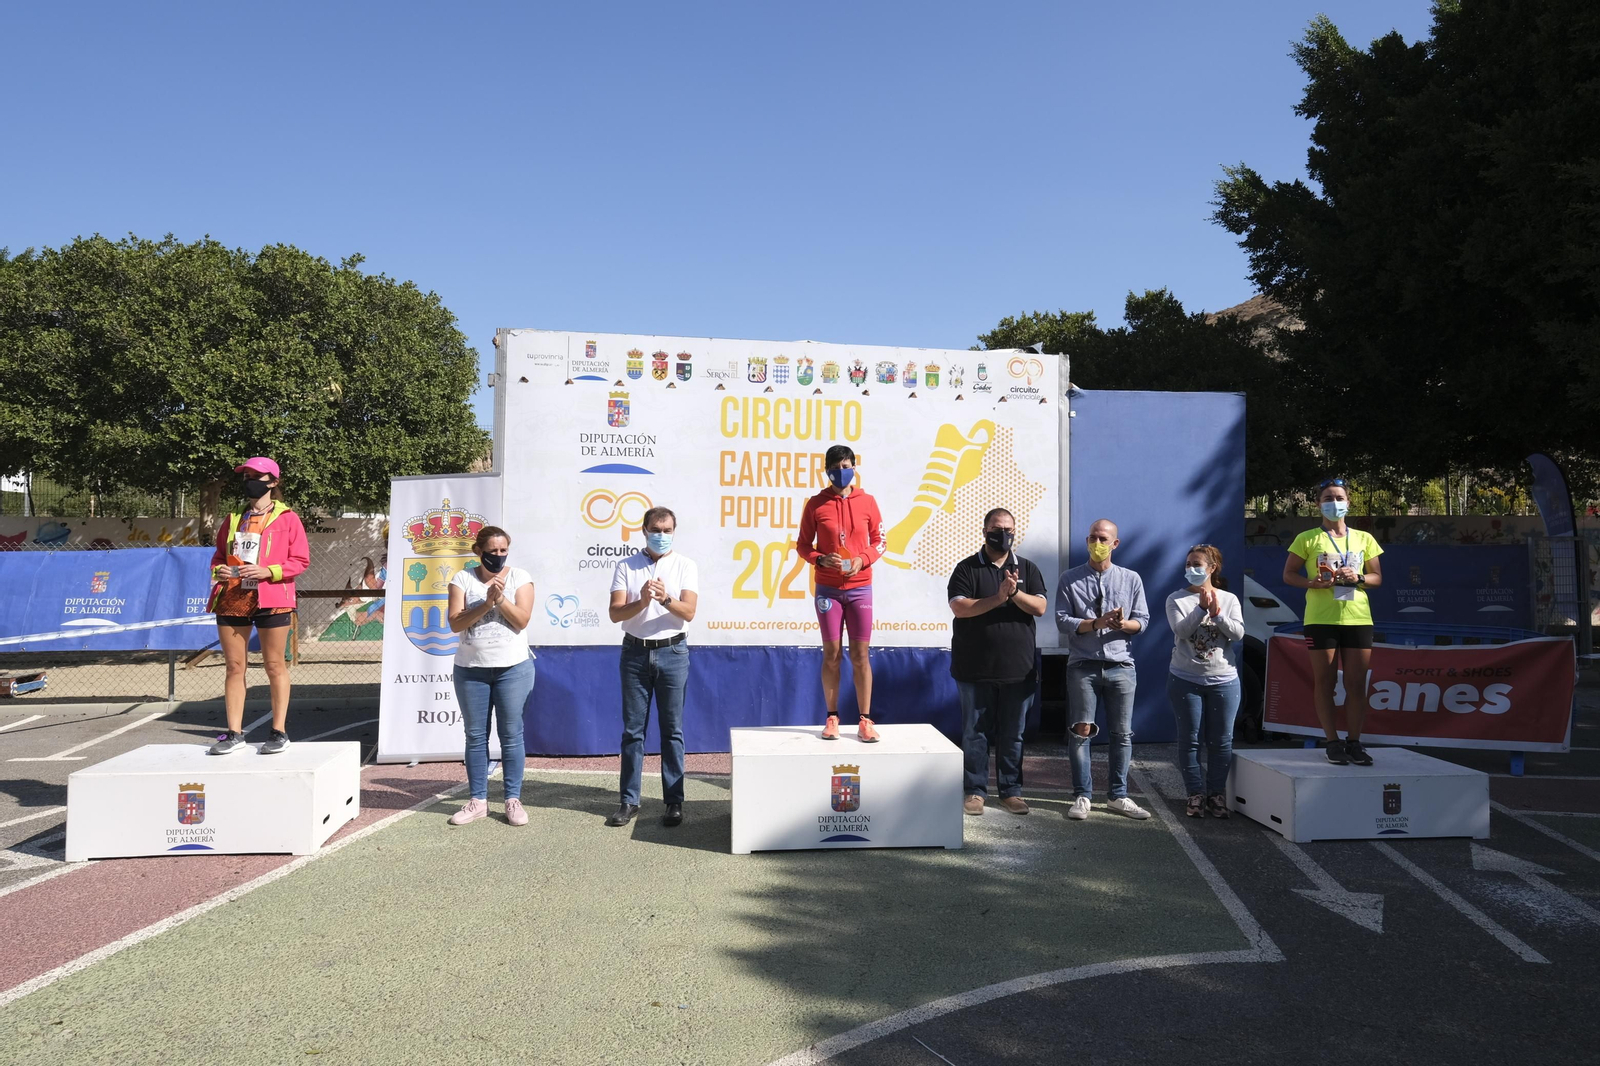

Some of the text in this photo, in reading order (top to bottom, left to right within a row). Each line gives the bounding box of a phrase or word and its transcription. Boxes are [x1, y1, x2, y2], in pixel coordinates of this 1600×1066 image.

[720, 396, 862, 441] CIRCUITO
[580, 432, 657, 444] DIPUTACIÓN
[581, 445, 655, 457] DE ALMERÍA
[719, 450, 862, 488] CARRERS
[720, 496, 808, 528] POPUL
[241, 541, 258, 549] 107
[587, 544, 640, 556] circuito
[579, 558, 617, 571] provin
[1396, 588, 1436, 596] DIPUTACIÓN
[1476, 587, 1514, 595] DIPUTACIÓN
[65, 597, 126, 605] DIPUTACIÓN
[64, 606, 122, 614] DE ALMERÍA
[1395, 667, 1512, 677] SPORT & SHOES
[394, 674, 453, 683] AYUNTAM
[434, 692, 451, 700] DE
[818, 814, 871, 823] DIPUTACIÓN
[165, 827, 216, 836] DIPUTACIÓN
[819, 823, 869, 832] DE ALMERÍA
[180, 835, 214, 843] ALMERÍA
